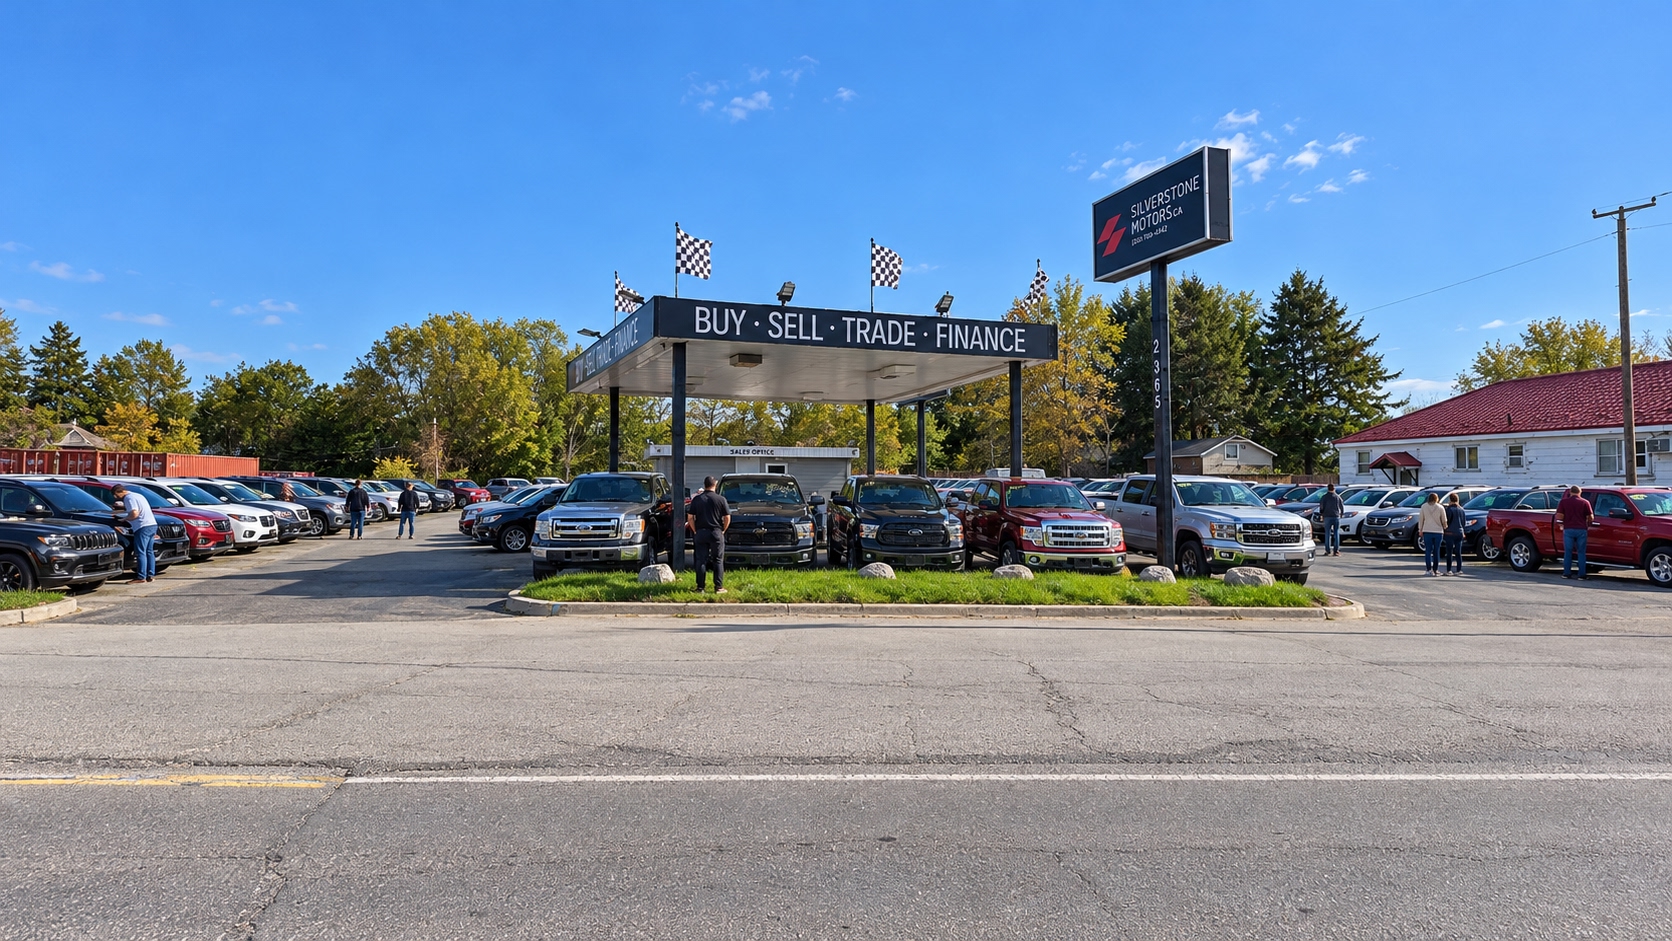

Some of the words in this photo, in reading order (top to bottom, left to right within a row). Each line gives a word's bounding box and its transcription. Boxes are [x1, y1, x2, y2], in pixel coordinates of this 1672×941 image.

[1130, 174, 1200, 218] SILVERSTONE
[1131, 205, 1172, 235] MOTORS
[695, 306, 747, 336] BUY
[767, 311, 824, 341] SELL
[842, 316, 916, 346] TRADE
[936, 323, 1026, 353] FINANCE
[1153, 339, 1161, 409] 2365
